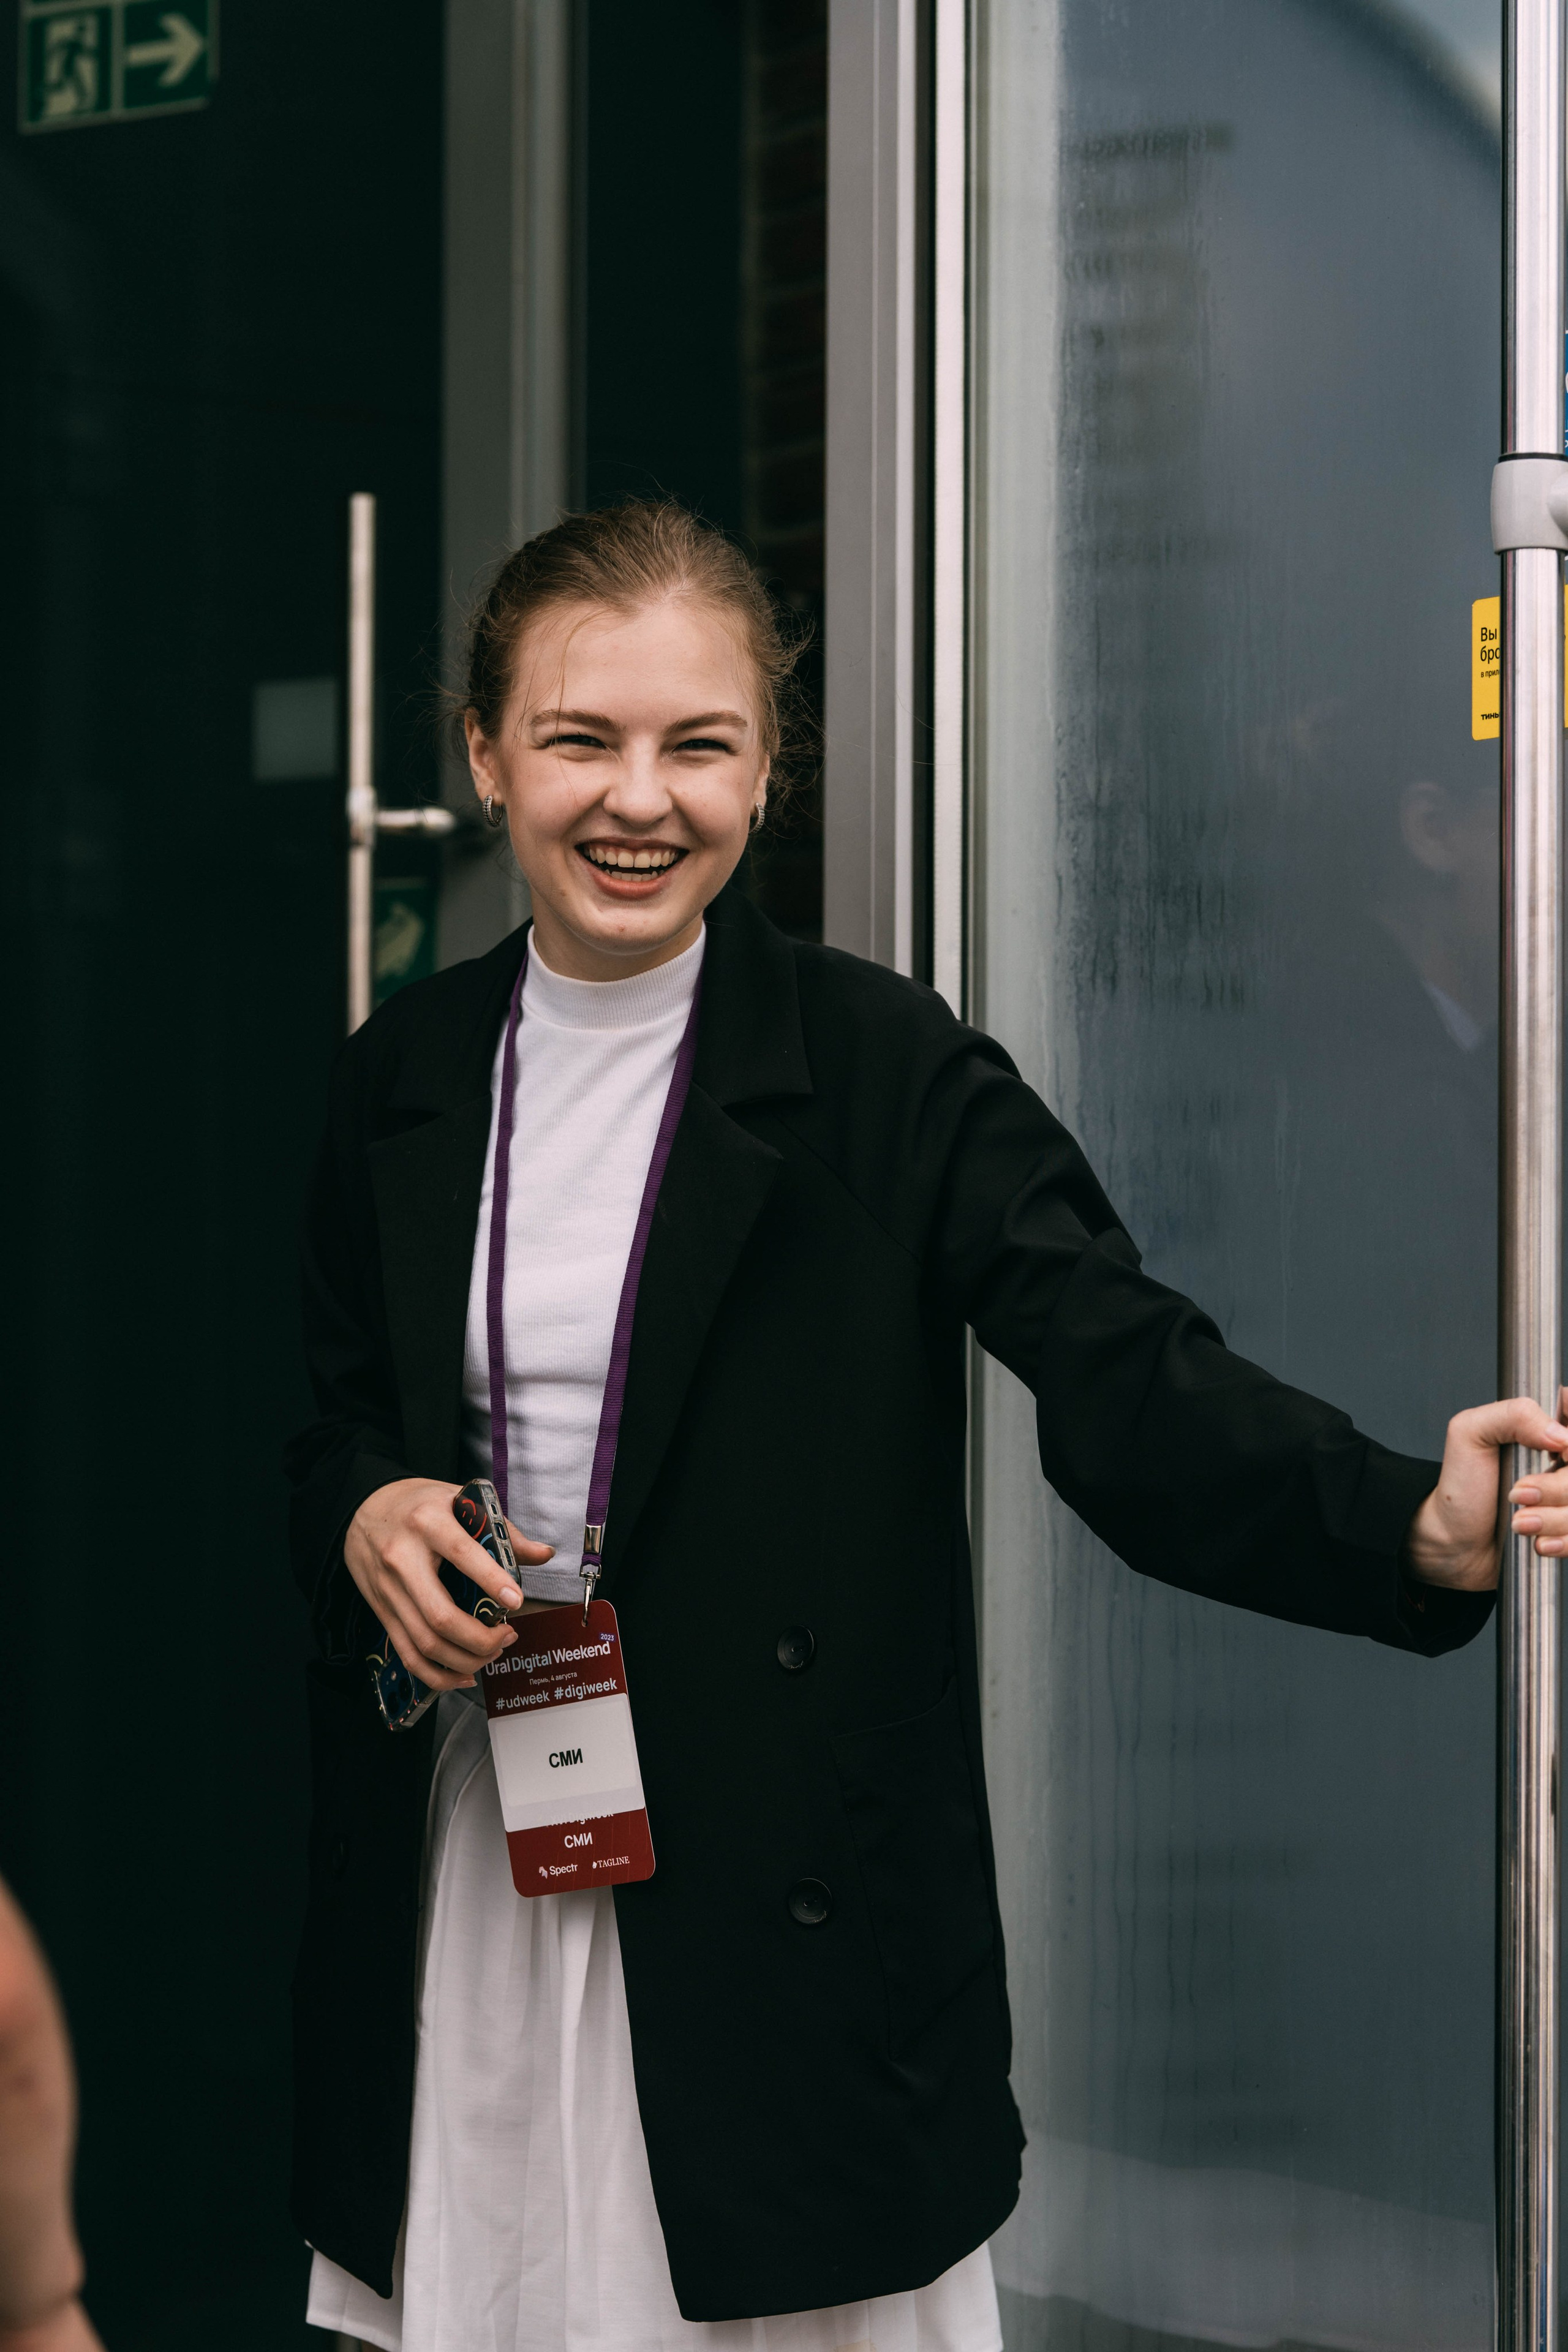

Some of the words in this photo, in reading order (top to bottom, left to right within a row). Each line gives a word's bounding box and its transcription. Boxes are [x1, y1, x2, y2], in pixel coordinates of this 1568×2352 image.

[1481, 627, 1497, 641] Вы
[1485, 669, 1499, 678] прил
[485, 1658, 511, 1676] Ural
[511, 1651, 552, 1673] Digital
[552, 1641, 611, 1664] Weekend
[529, 1676, 550, 1685] Пермь,
[556, 1672, 577, 1681] августа
[496, 1690, 550, 1710] #udweek
[554, 1678, 617, 1700] #digiweek
[549, 1748, 583, 1768] СМИ
[564, 1832, 593, 1849] СМИ
[597, 1856, 630, 1868] TAGLINE
[549, 1863, 578, 1877] Spectr
